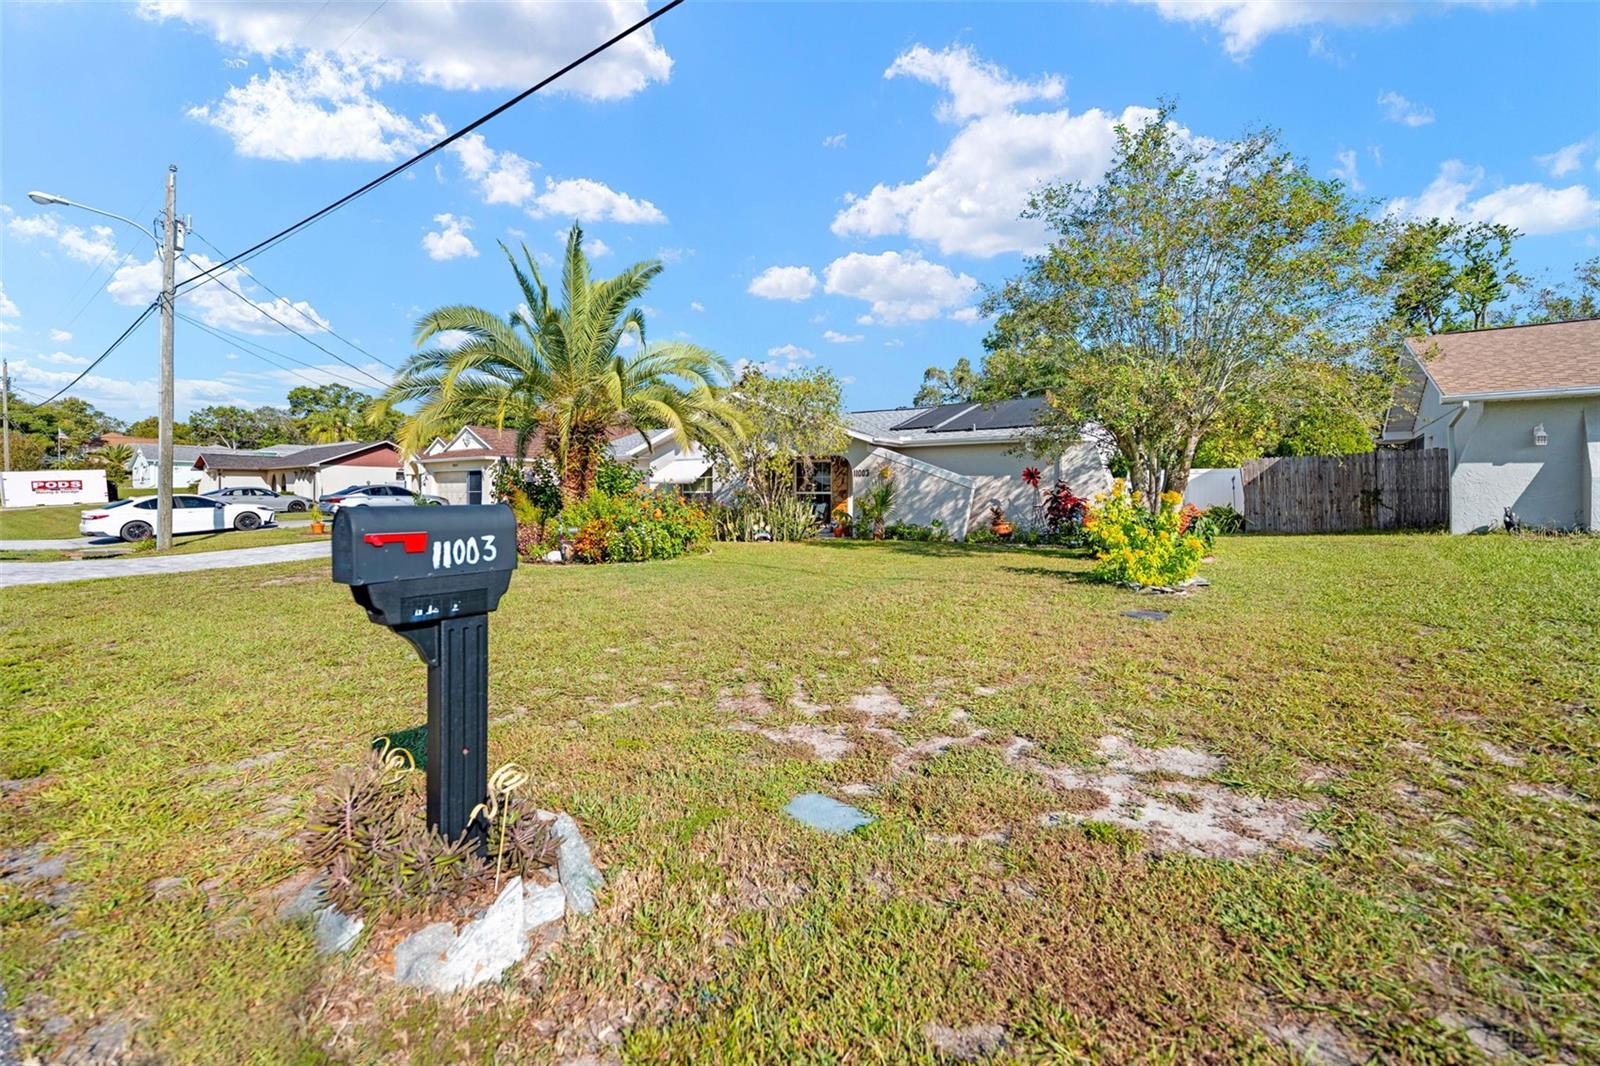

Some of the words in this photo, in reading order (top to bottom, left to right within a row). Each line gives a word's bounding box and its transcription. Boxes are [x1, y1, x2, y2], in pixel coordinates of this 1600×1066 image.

[853, 469, 870, 477] 11003
[32, 480, 81, 490] PODS
[432, 534, 497, 570] 11003
